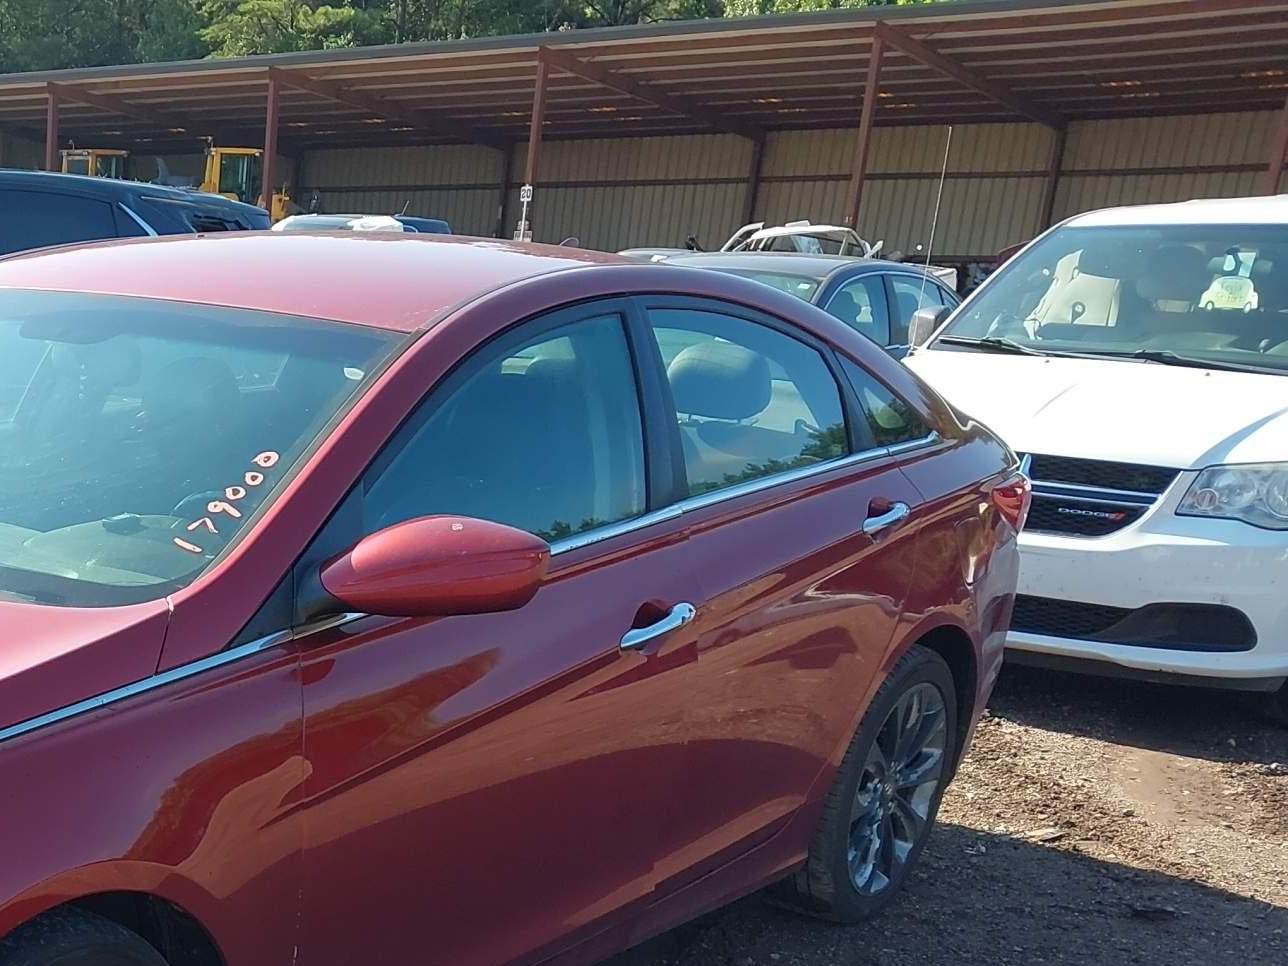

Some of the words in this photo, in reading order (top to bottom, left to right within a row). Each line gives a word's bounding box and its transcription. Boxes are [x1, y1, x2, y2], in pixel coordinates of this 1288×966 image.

[521, 188, 532, 199] 20
[173, 451, 280, 553] 179000
[1058, 507, 1112, 519] DODGE
